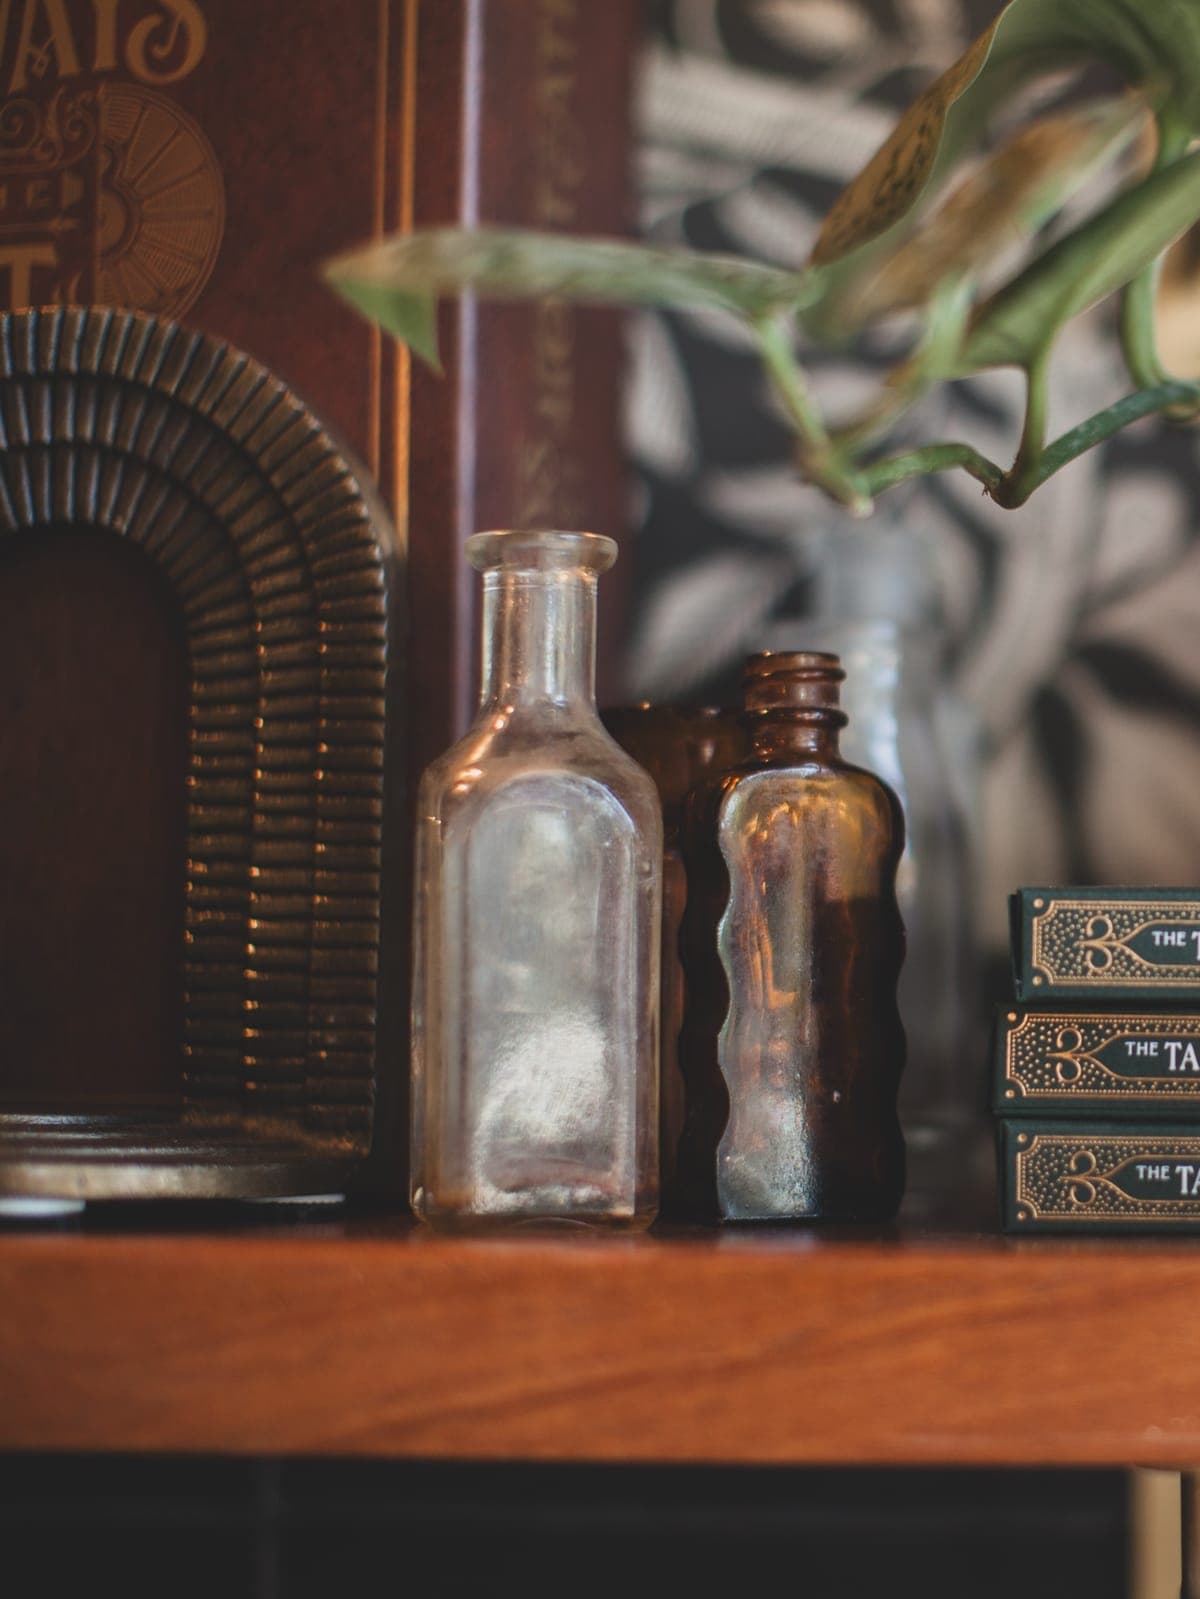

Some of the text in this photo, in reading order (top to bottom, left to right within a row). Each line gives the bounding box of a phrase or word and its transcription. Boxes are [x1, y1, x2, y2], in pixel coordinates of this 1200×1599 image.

[1151, 930, 1187, 947] THE
[1124, 1041, 1159, 1057] THE
[1135, 1165, 1170, 1180] THE
